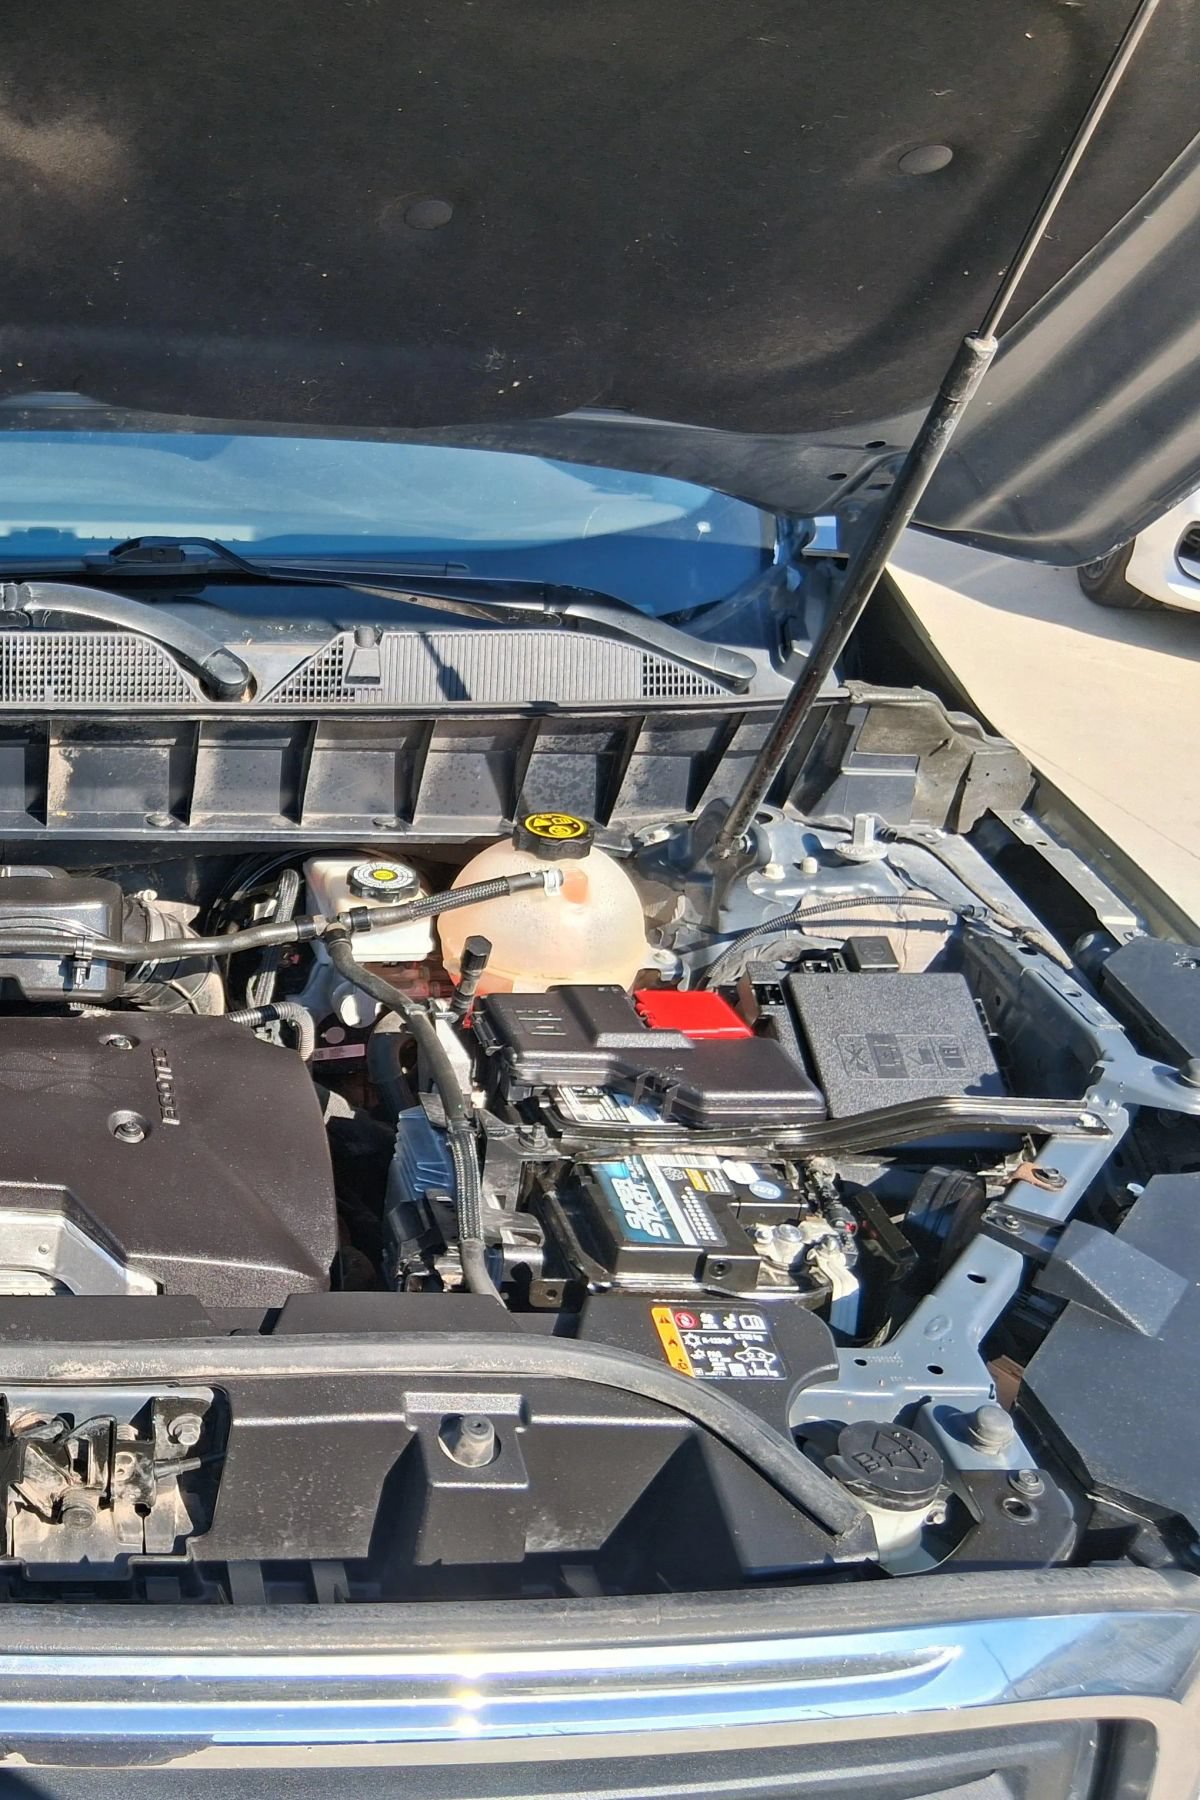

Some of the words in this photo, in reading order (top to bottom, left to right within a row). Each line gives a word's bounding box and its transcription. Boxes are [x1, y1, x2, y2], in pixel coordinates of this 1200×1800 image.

[150, 1047, 181, 1126] ECOTEC
[611, 1177, 645, 1230] SUPER
[631, 1178, 671, 1240] START
